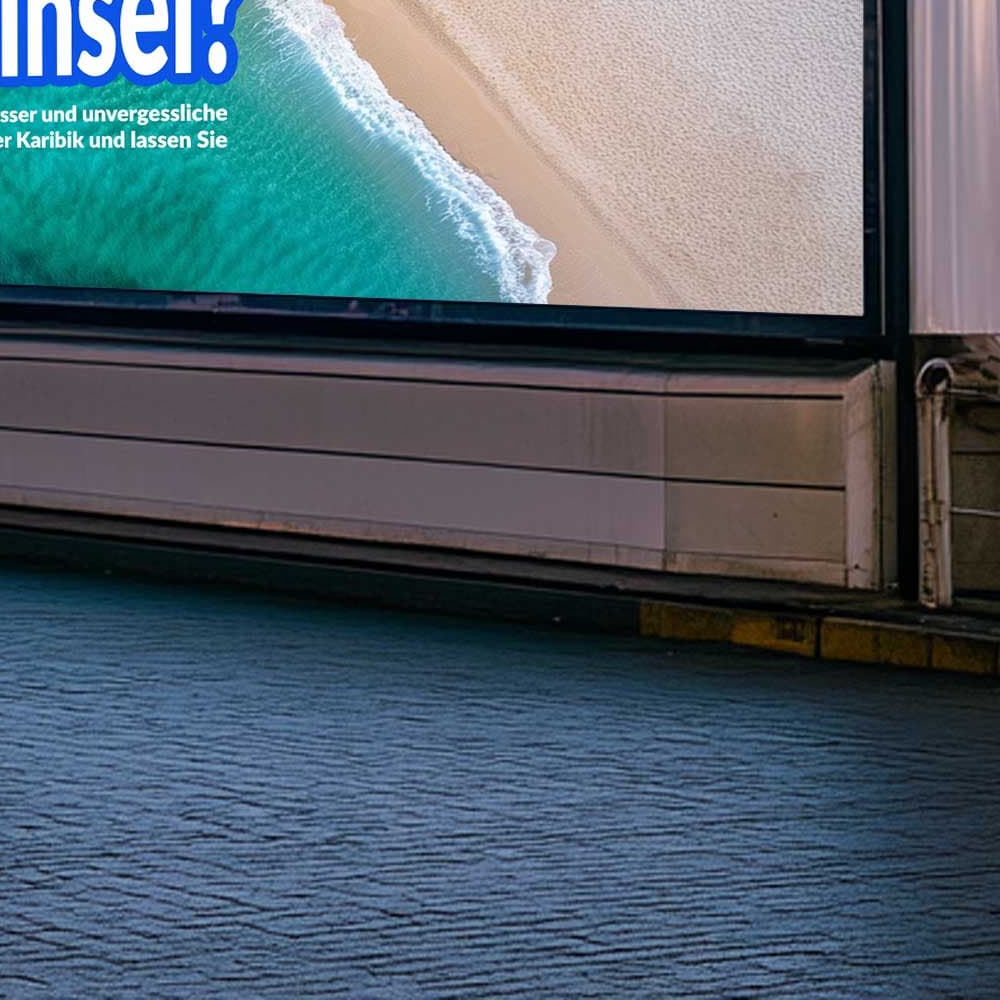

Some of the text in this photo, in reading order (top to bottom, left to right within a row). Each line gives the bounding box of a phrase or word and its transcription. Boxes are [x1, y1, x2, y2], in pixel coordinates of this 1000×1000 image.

[41, 104, 77, 123] und
[82, 103, 228, 126] unvergessliche
[16, 130, 85, 149] Karibik
[89, 130, 125, 149] und
[130, 130, 192, 149] lassen
[196, 130, 228, 149] Sie
